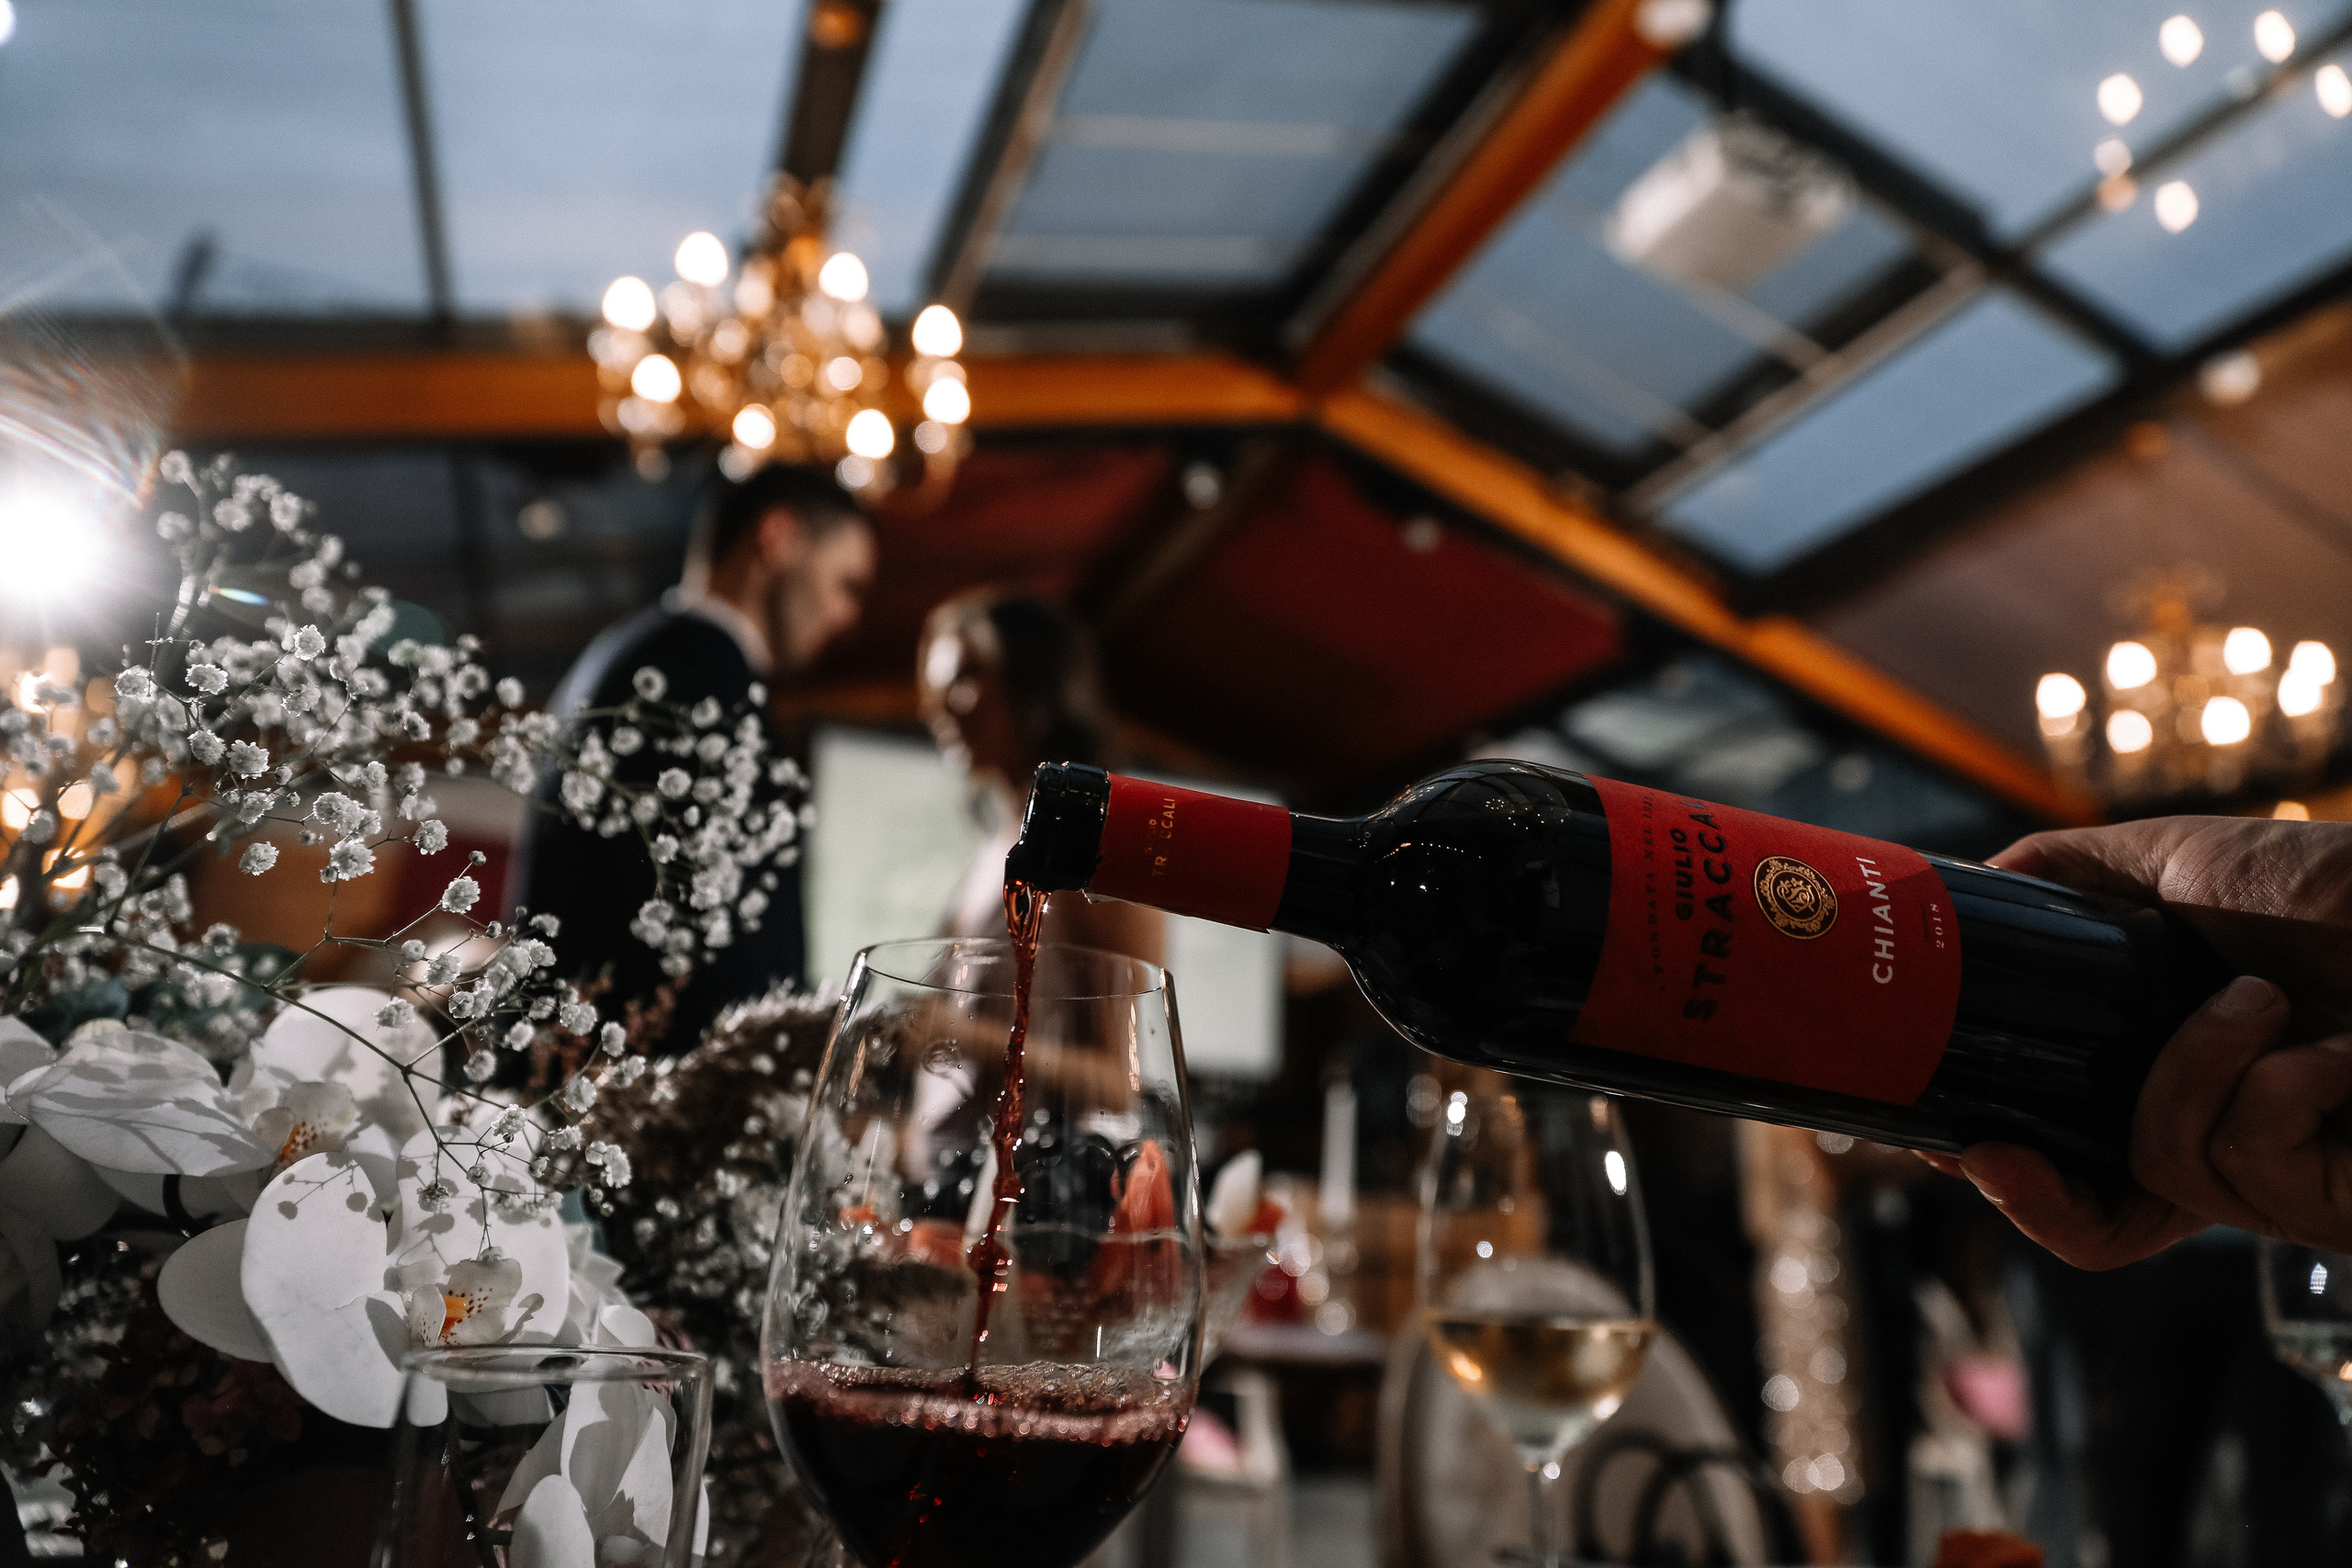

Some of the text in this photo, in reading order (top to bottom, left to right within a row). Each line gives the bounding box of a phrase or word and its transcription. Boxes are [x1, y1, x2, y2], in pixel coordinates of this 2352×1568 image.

[1644, 828, 1655, 861] NEL
[1670, 828, 1694, 921] GIULIO
[1856, 856, 1894, 984] CHIANTI
[1930, 903, 1945, 949] 2018
